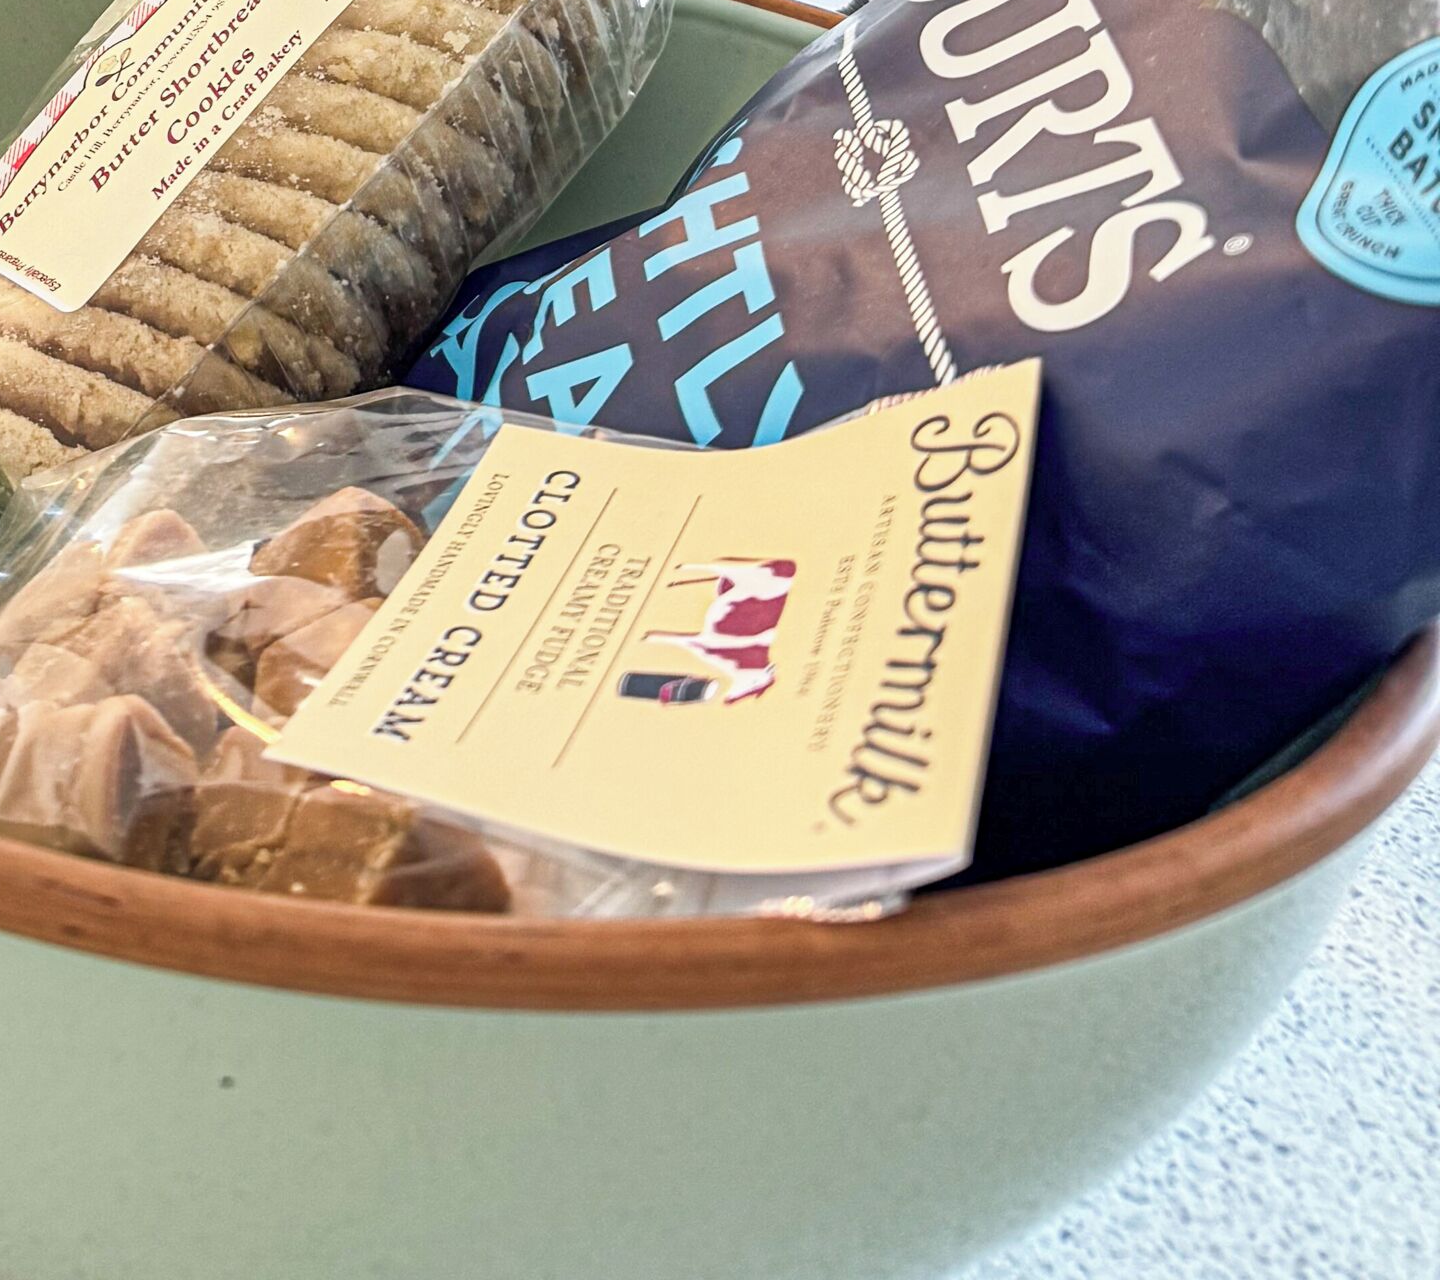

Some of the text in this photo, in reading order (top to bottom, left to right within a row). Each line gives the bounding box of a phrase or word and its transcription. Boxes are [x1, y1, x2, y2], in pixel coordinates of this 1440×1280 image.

[151, 29, 304, 200] Made in a Craft Bakery
[167, 47, 255, 145] Cookies
[1400, 63, 1440, 92] MAD
[57, 160, 87, 192] Castle
[89, 109, 160, 193] Butter
[24, 265, 62, 292] Especially
[456, 472, 510, 542] LOVINGLY
[467, 469, 582, 612] CLOTTED
[399, 539, 467, 616] HANDMADE
[515, 542, 622, 695] CREAMY FUDGE
[829, 411, 1021, 827] Buttermilk
[390, 617, 411, 635] IN
[556, 556, 652, 690] TRADITIONAL
[327, 634, 397, 708] CORNWALL
[372, 624, 483, 743] CREAM
